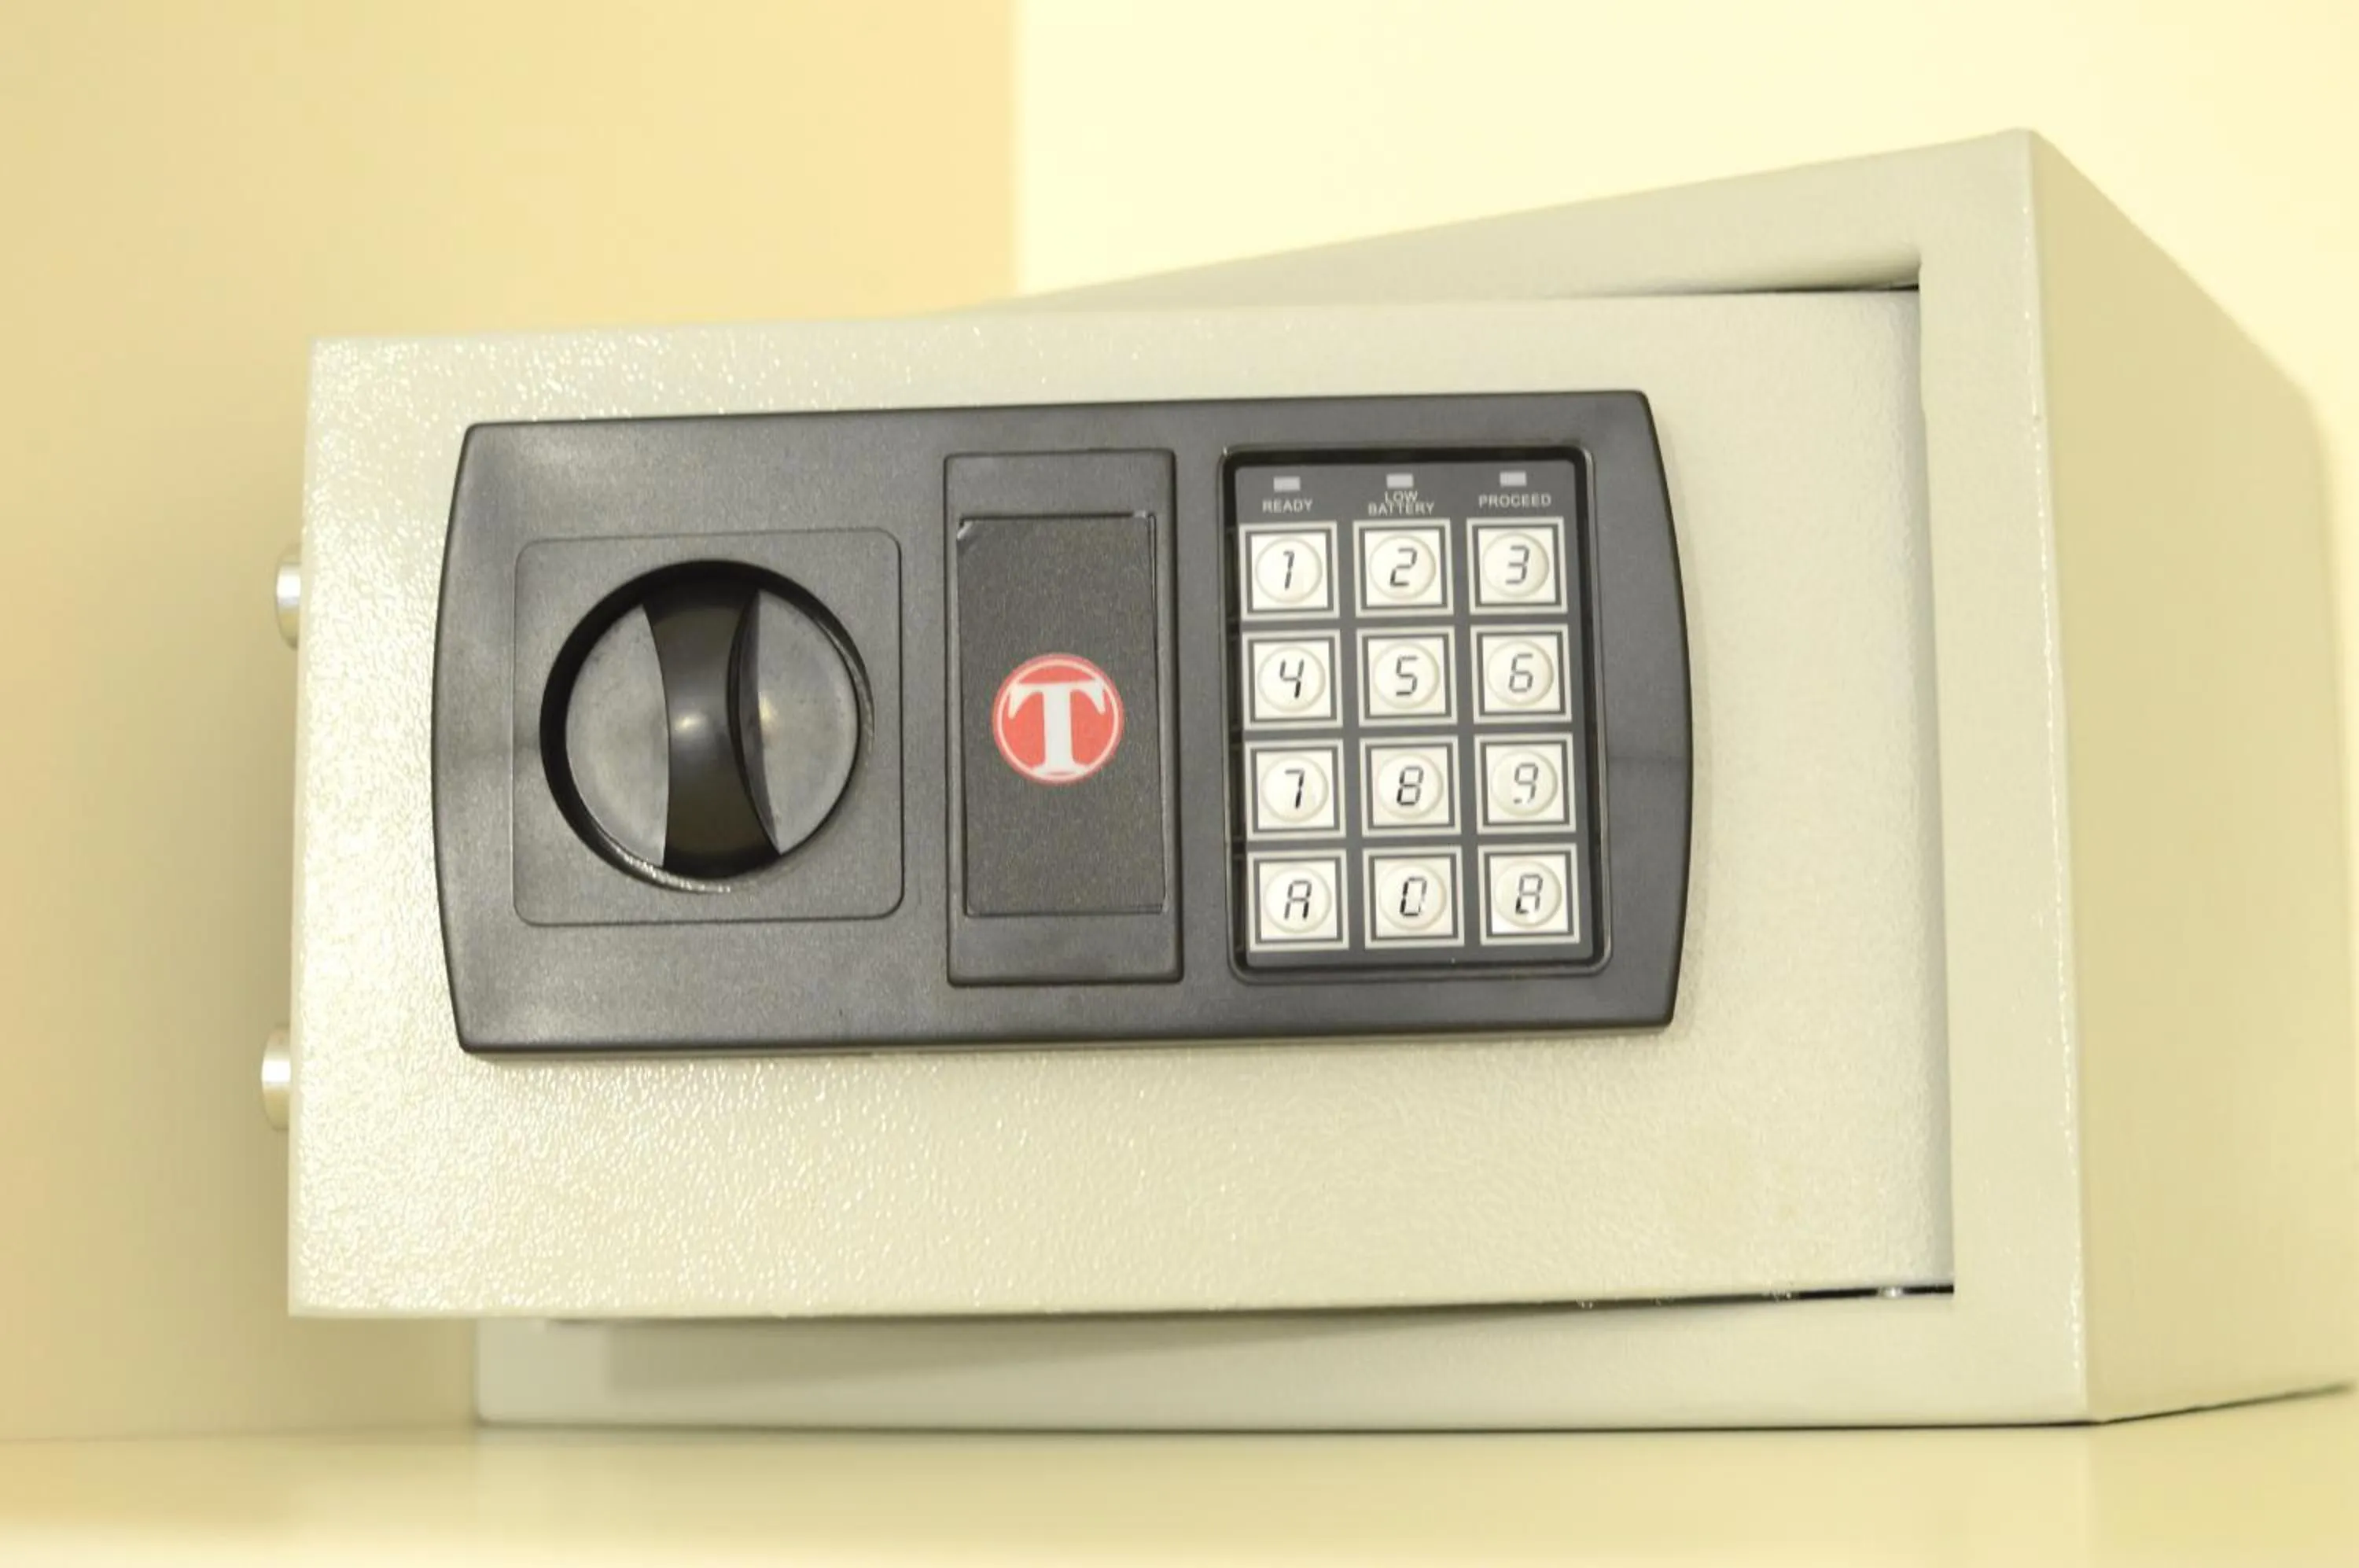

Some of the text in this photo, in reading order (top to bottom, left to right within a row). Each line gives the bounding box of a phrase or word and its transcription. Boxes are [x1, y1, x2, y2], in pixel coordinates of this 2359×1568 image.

[1262, 499, 1313, 513] READY
[1367, 501, 1435, 516] BATTERY
[1384, 490, 1419, 504] LOW
[1478, 493, 1551, 508] PROCEED
[1283, 550, 1296, 590] 1
[1389, 548, 1418, 587] 2
[1505, 544, 1530, 585] 3
[1279, 659, 1305, 699] 4
[1396, 655, 1419, 697] 5
[1509, 653, 1534, 693] 6
[1008, 679, 1106, 775] T
[1284, 768, 1305, 809] 7
[1396, 766, 1424, 806] 8
[1514, 763, 1539, 804] 9
[1284, 880, 1312, 920] A
